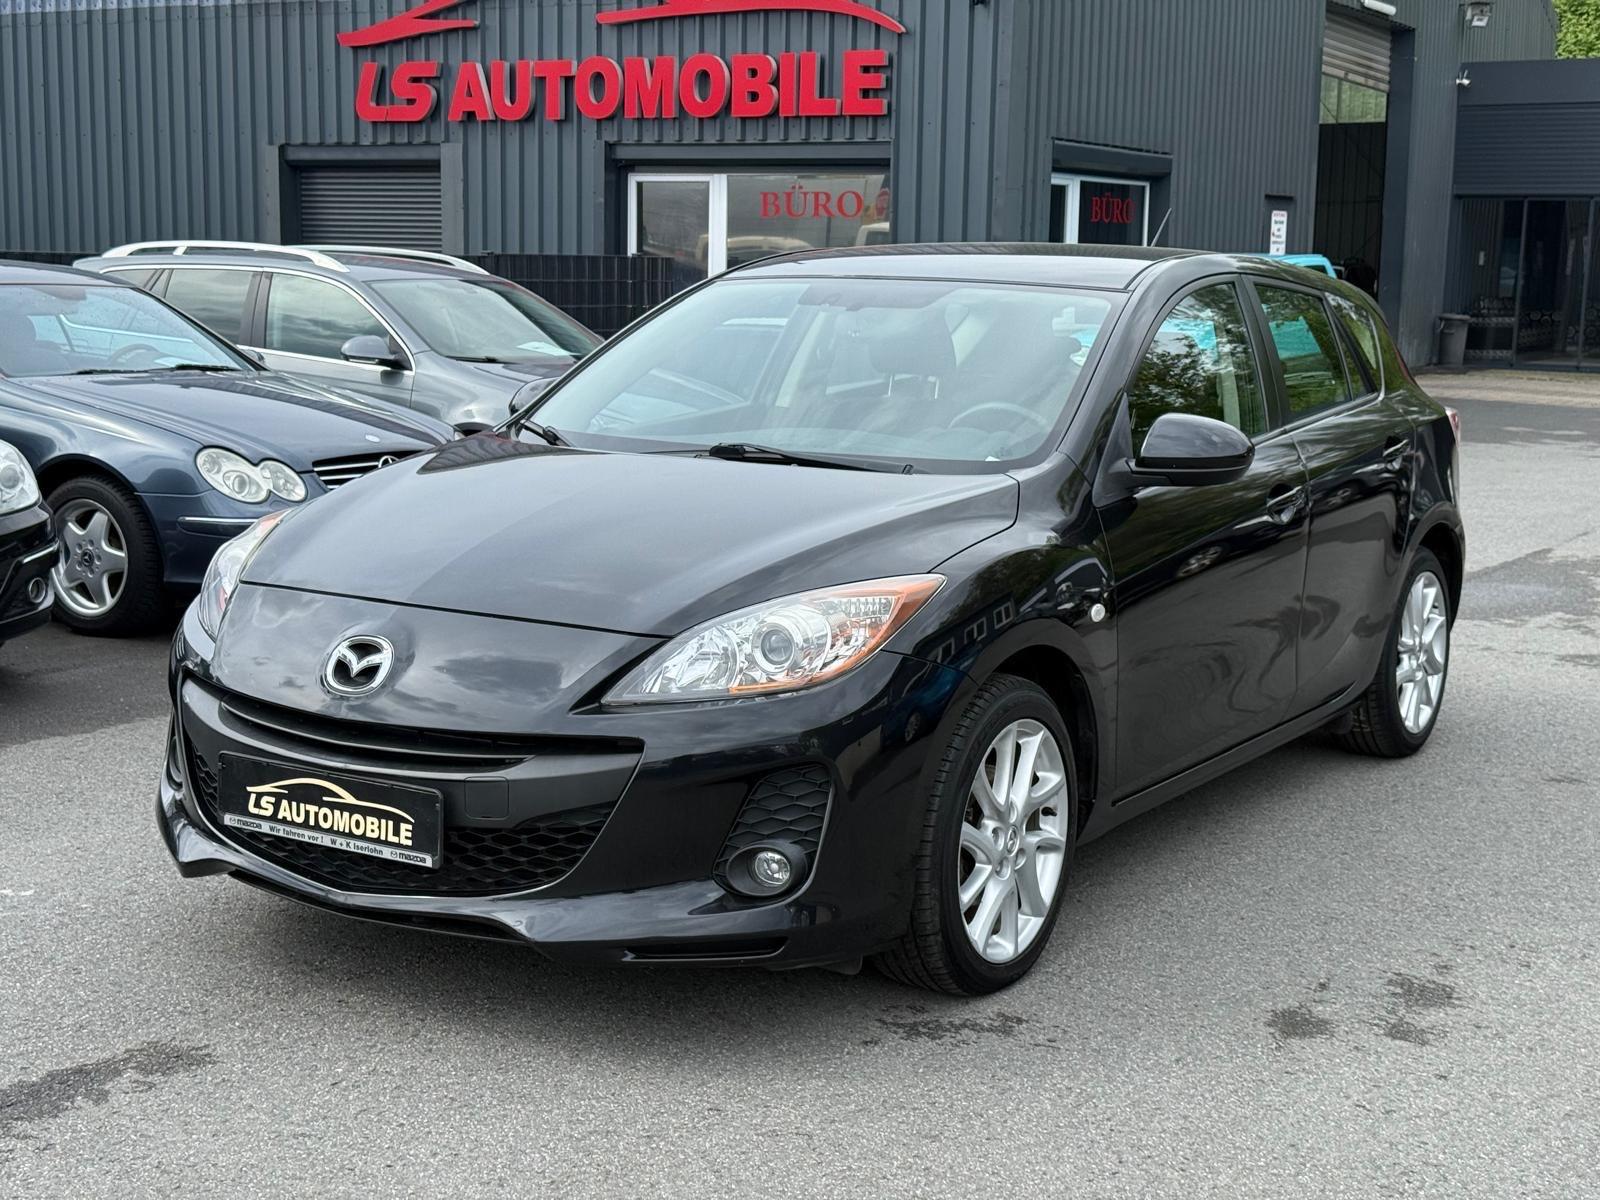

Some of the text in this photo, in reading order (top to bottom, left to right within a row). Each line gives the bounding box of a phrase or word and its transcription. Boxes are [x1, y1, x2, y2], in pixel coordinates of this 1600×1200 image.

[355, 49, 888, 121] LS AUTOMOBILE
[760, 185, 864, 219] BÜRO
[1090, 191, 1136, 224] BÜRO
[236, 819, 262, 830] mazda
[269, 825, 280, 834] Wir
[282, 828, 306, 839] fahren
[330, 837, 337, 846] W
[345, 841, 351, 849] K
[353, 843, 384, 856] Iserlohn
[398, 852, 427, 864] mazda
[248, 793, 413, 847] LS AUTOMOBILE
